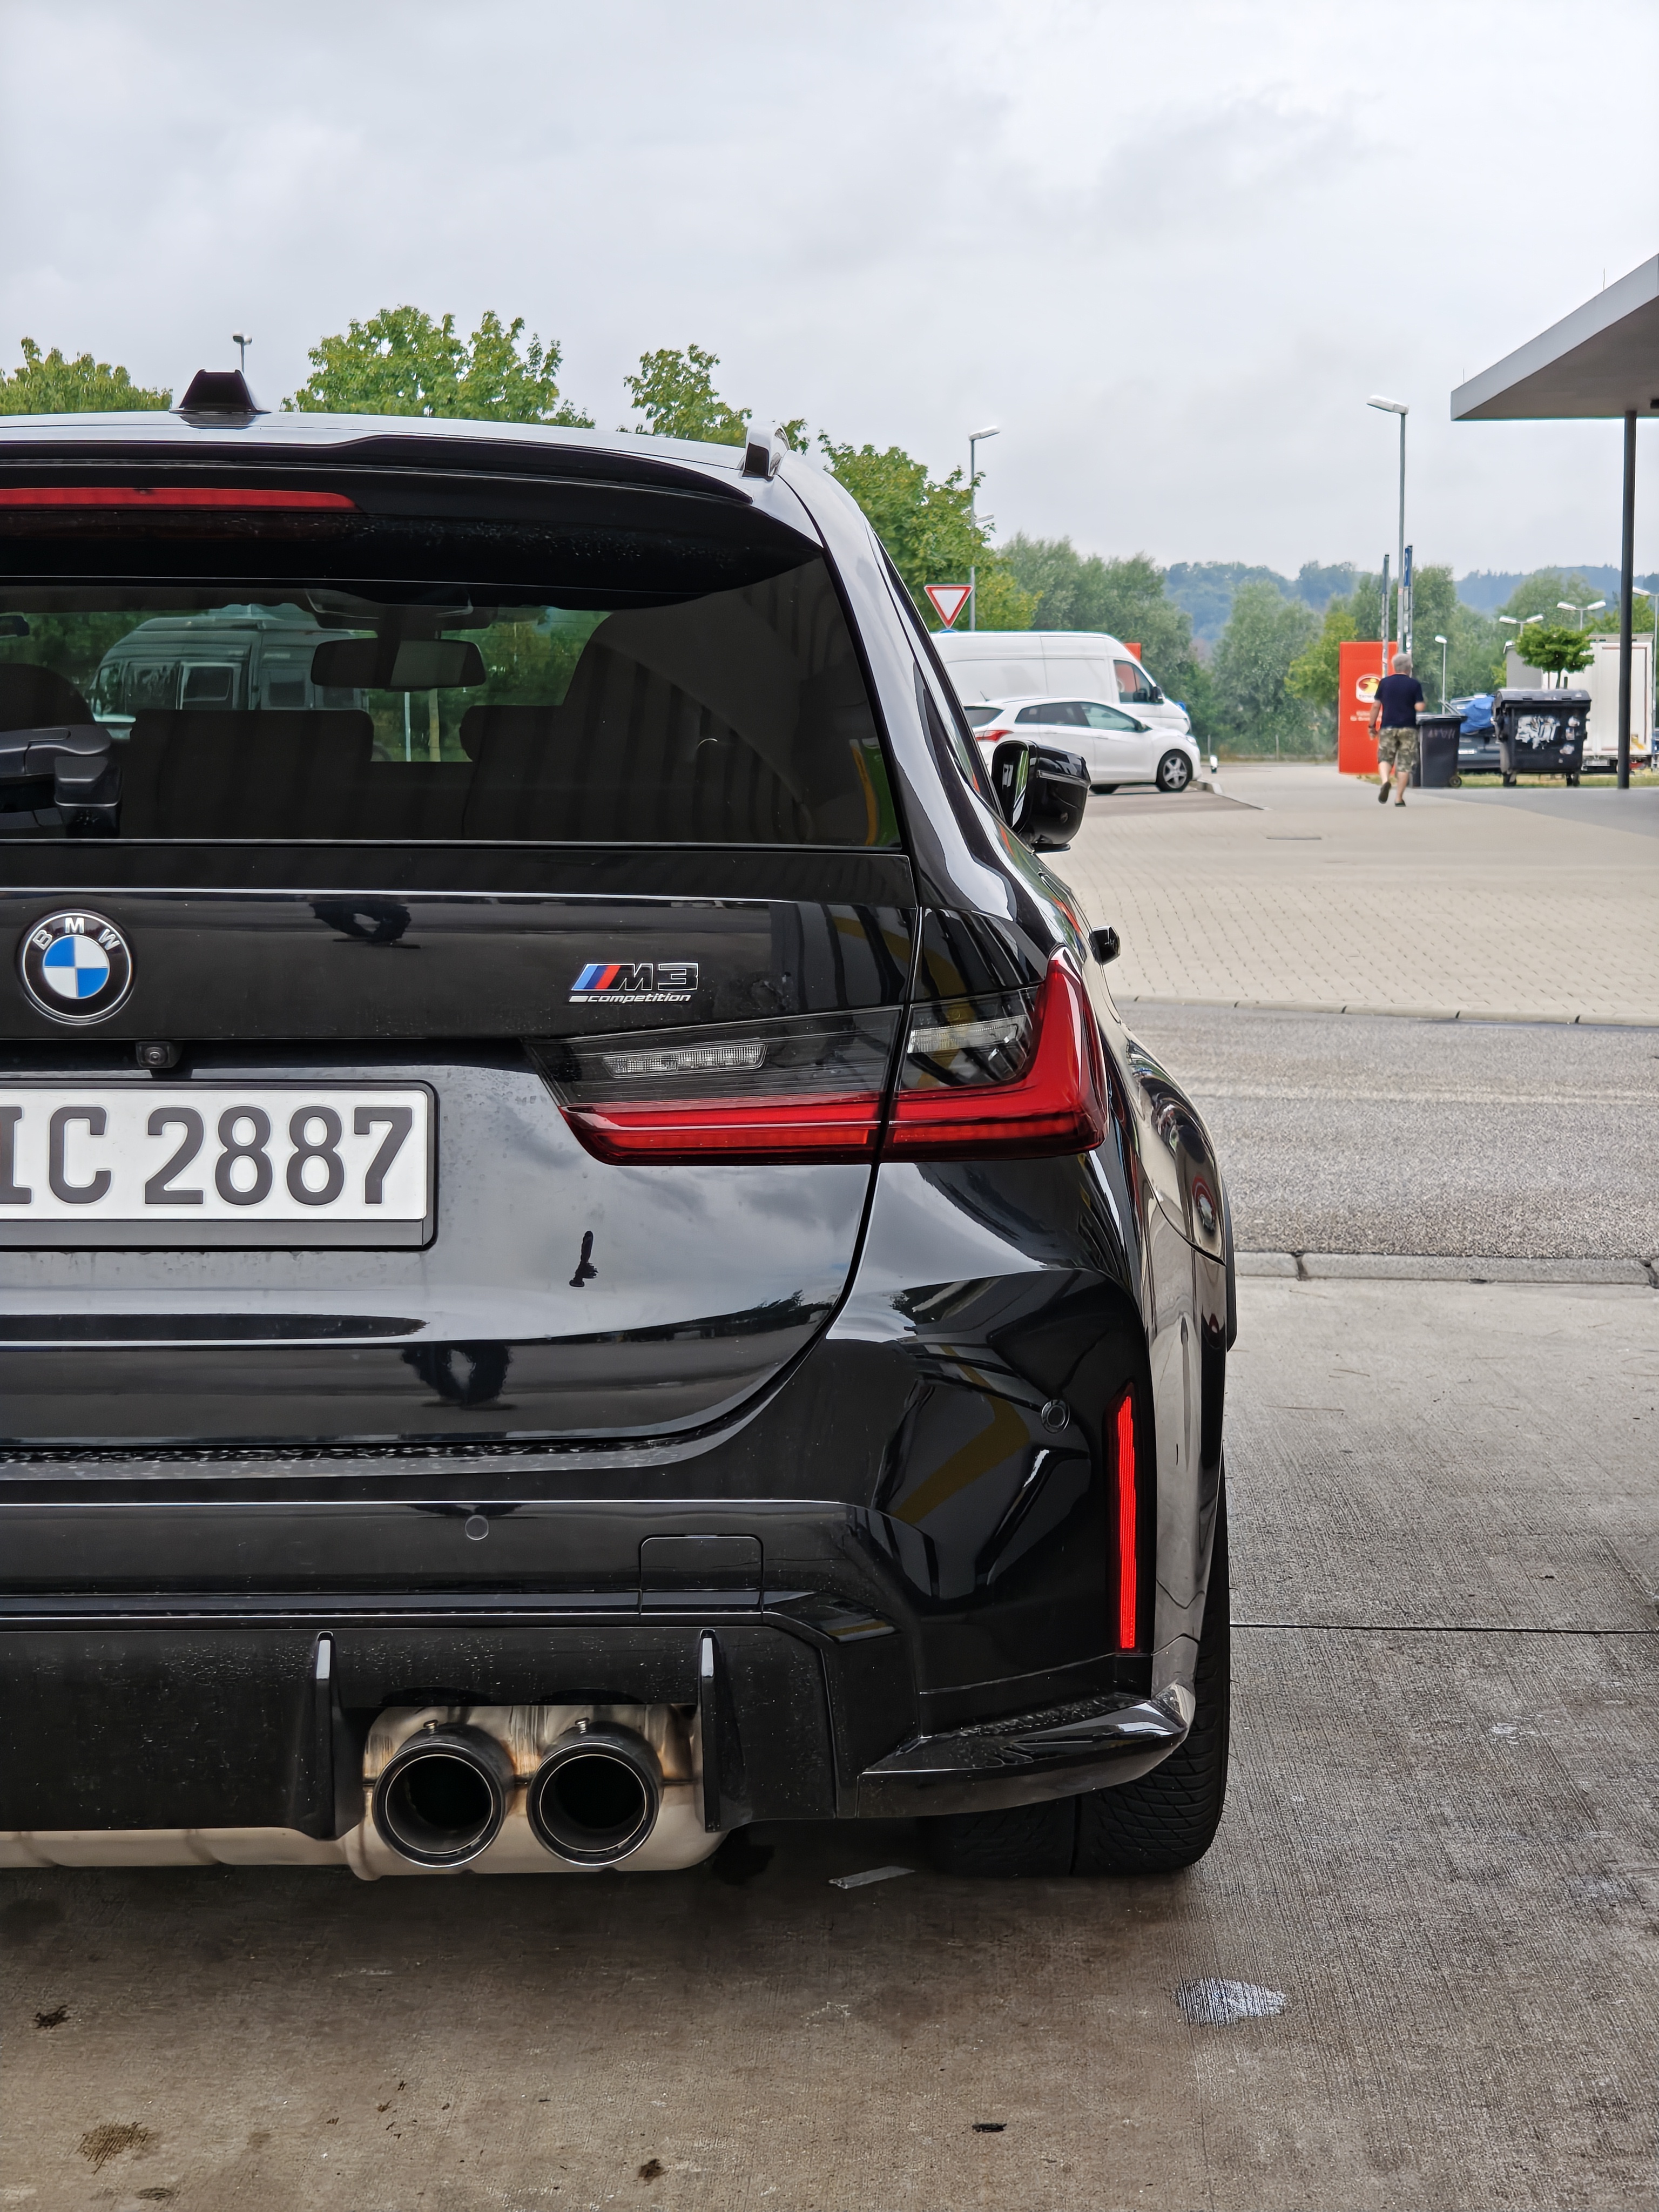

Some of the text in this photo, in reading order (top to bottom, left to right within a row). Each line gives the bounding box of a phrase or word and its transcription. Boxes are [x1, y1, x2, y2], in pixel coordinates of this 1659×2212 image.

[32, 918, 120, 950] BMW
[587, 993, 691, 1003] competition
[144, 1105, 413, 1206] 2887
